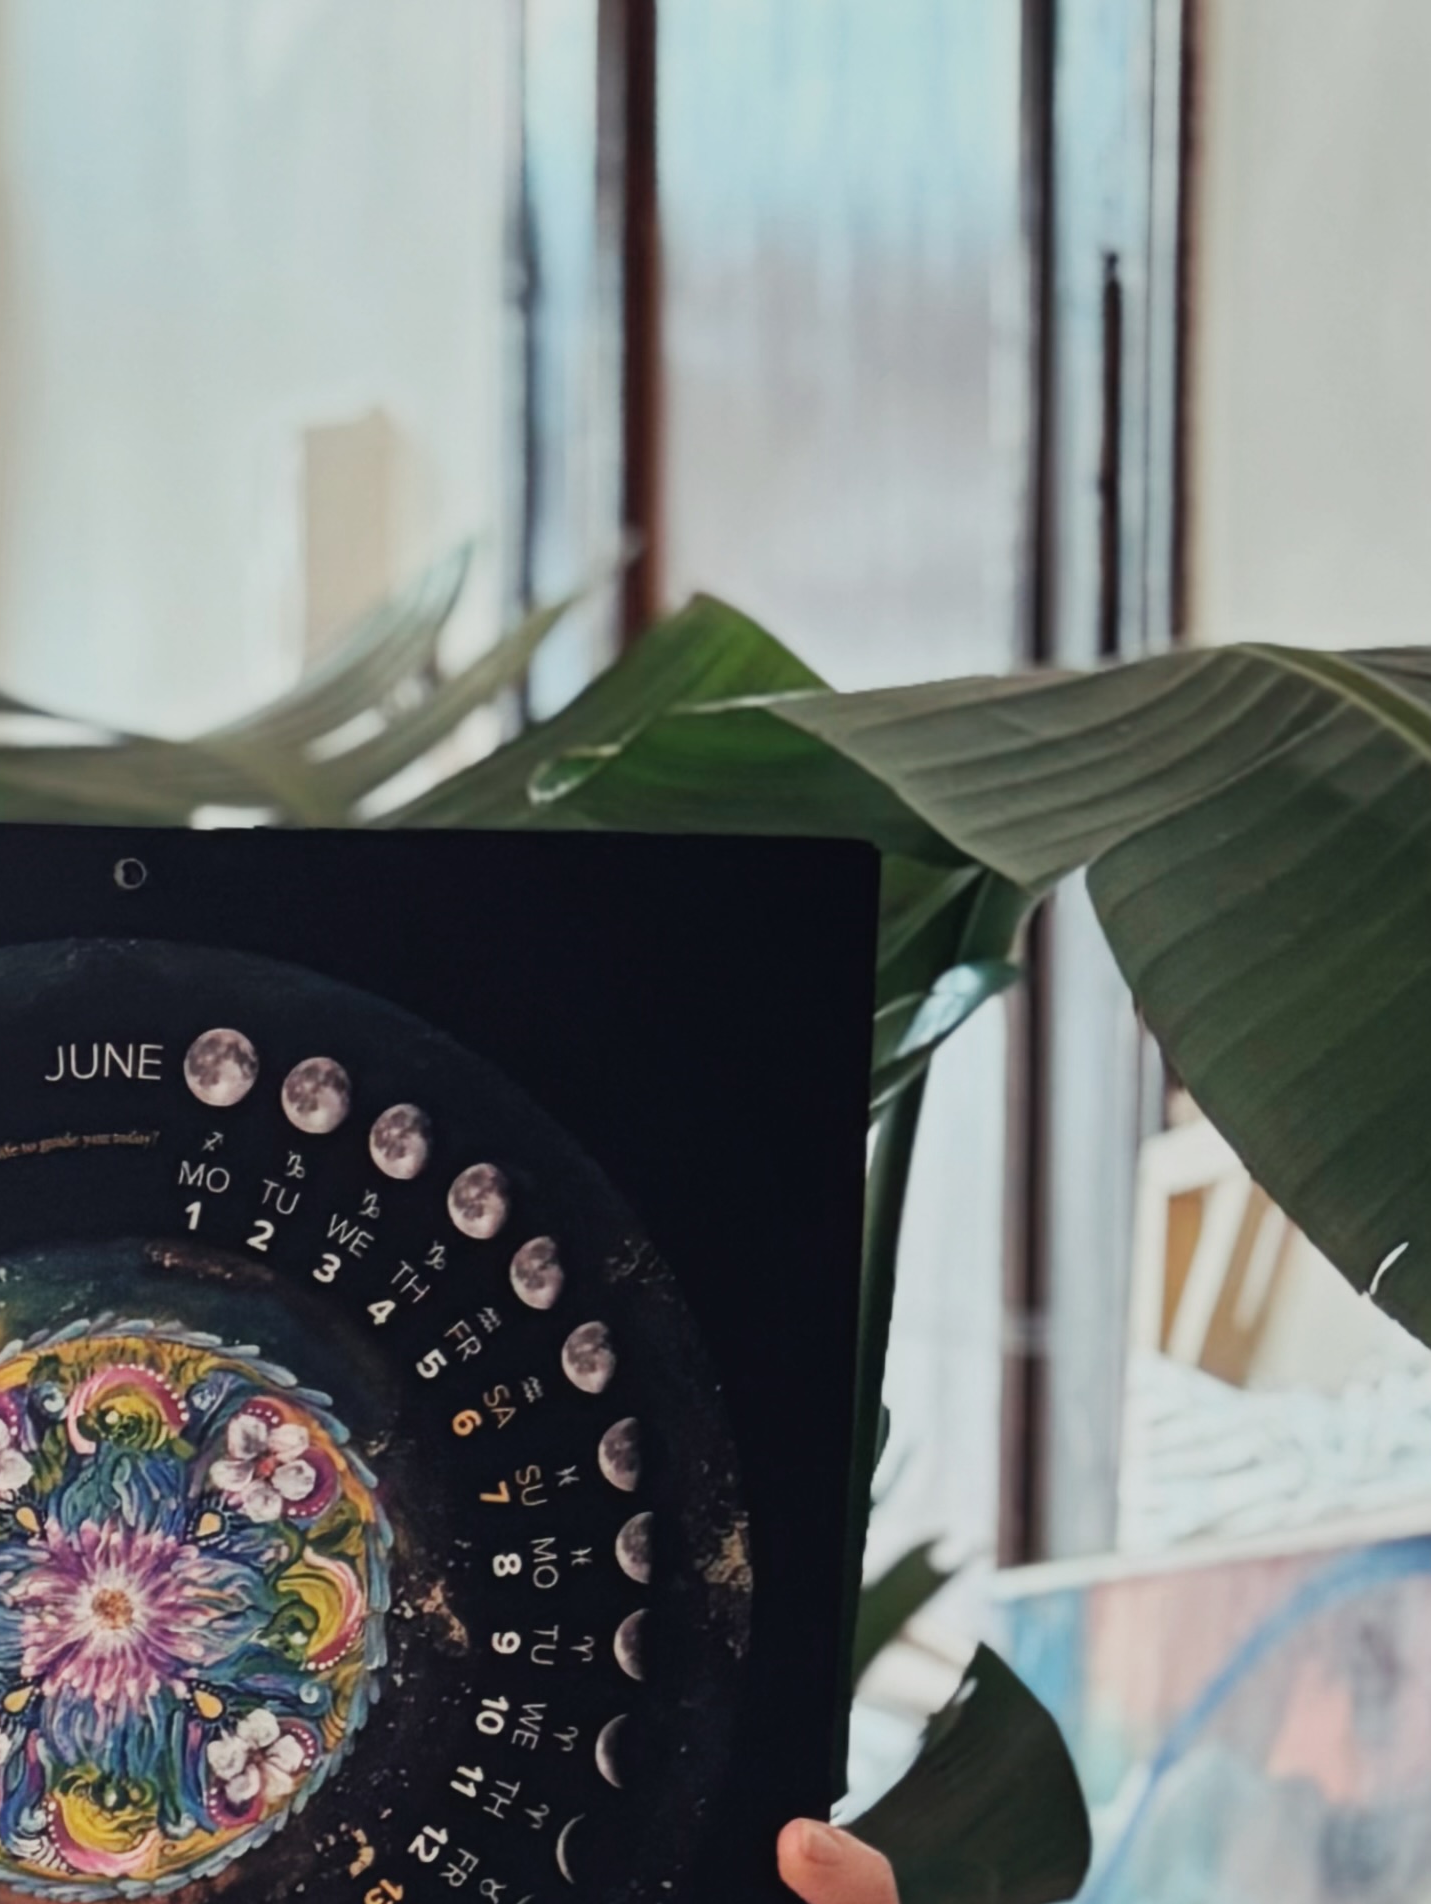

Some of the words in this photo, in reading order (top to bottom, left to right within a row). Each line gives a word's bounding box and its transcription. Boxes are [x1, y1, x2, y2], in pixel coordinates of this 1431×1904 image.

[45, 1043, 163, 1081] JUNE
[178, 1160, 230, 1193] MO
[185, 1201, 202, 1230] 1
[262, 1179, 300, 1215] TU
[246, 1220, 275, 1251] 2
[326, 1213, 375, 1258] WE
[312, 1253, 341, 1283] 3
[390, 1260, 430, 1303] TH
[367, 1299, 396, 1325] 4
[444, 1320, 482, 1361] FR
[416, 1349, 448, 1379] 5
[452, 1409, 483, 1435] 6
[483, 1384, 516, 1429] SA
[479, 1480, 511, 1503] 7
[515, 1464, 548, 1507] SU
[492, 1553, 522, 1577] 8
[530, 1537, 559, 1589] MO
[491, 1631, 521, 1655] 9
[530, 1625, 560, 1665] TU
[475, 1696, 510, 1735] 10
[511, 1703, 547, 1750] WE
[450, 1766, 484, 1798] 11
[482, 1780, 521, 1819] TH
[407, 1825, 449, 1863] 12
[439, 1848, 479, 1887] FR
